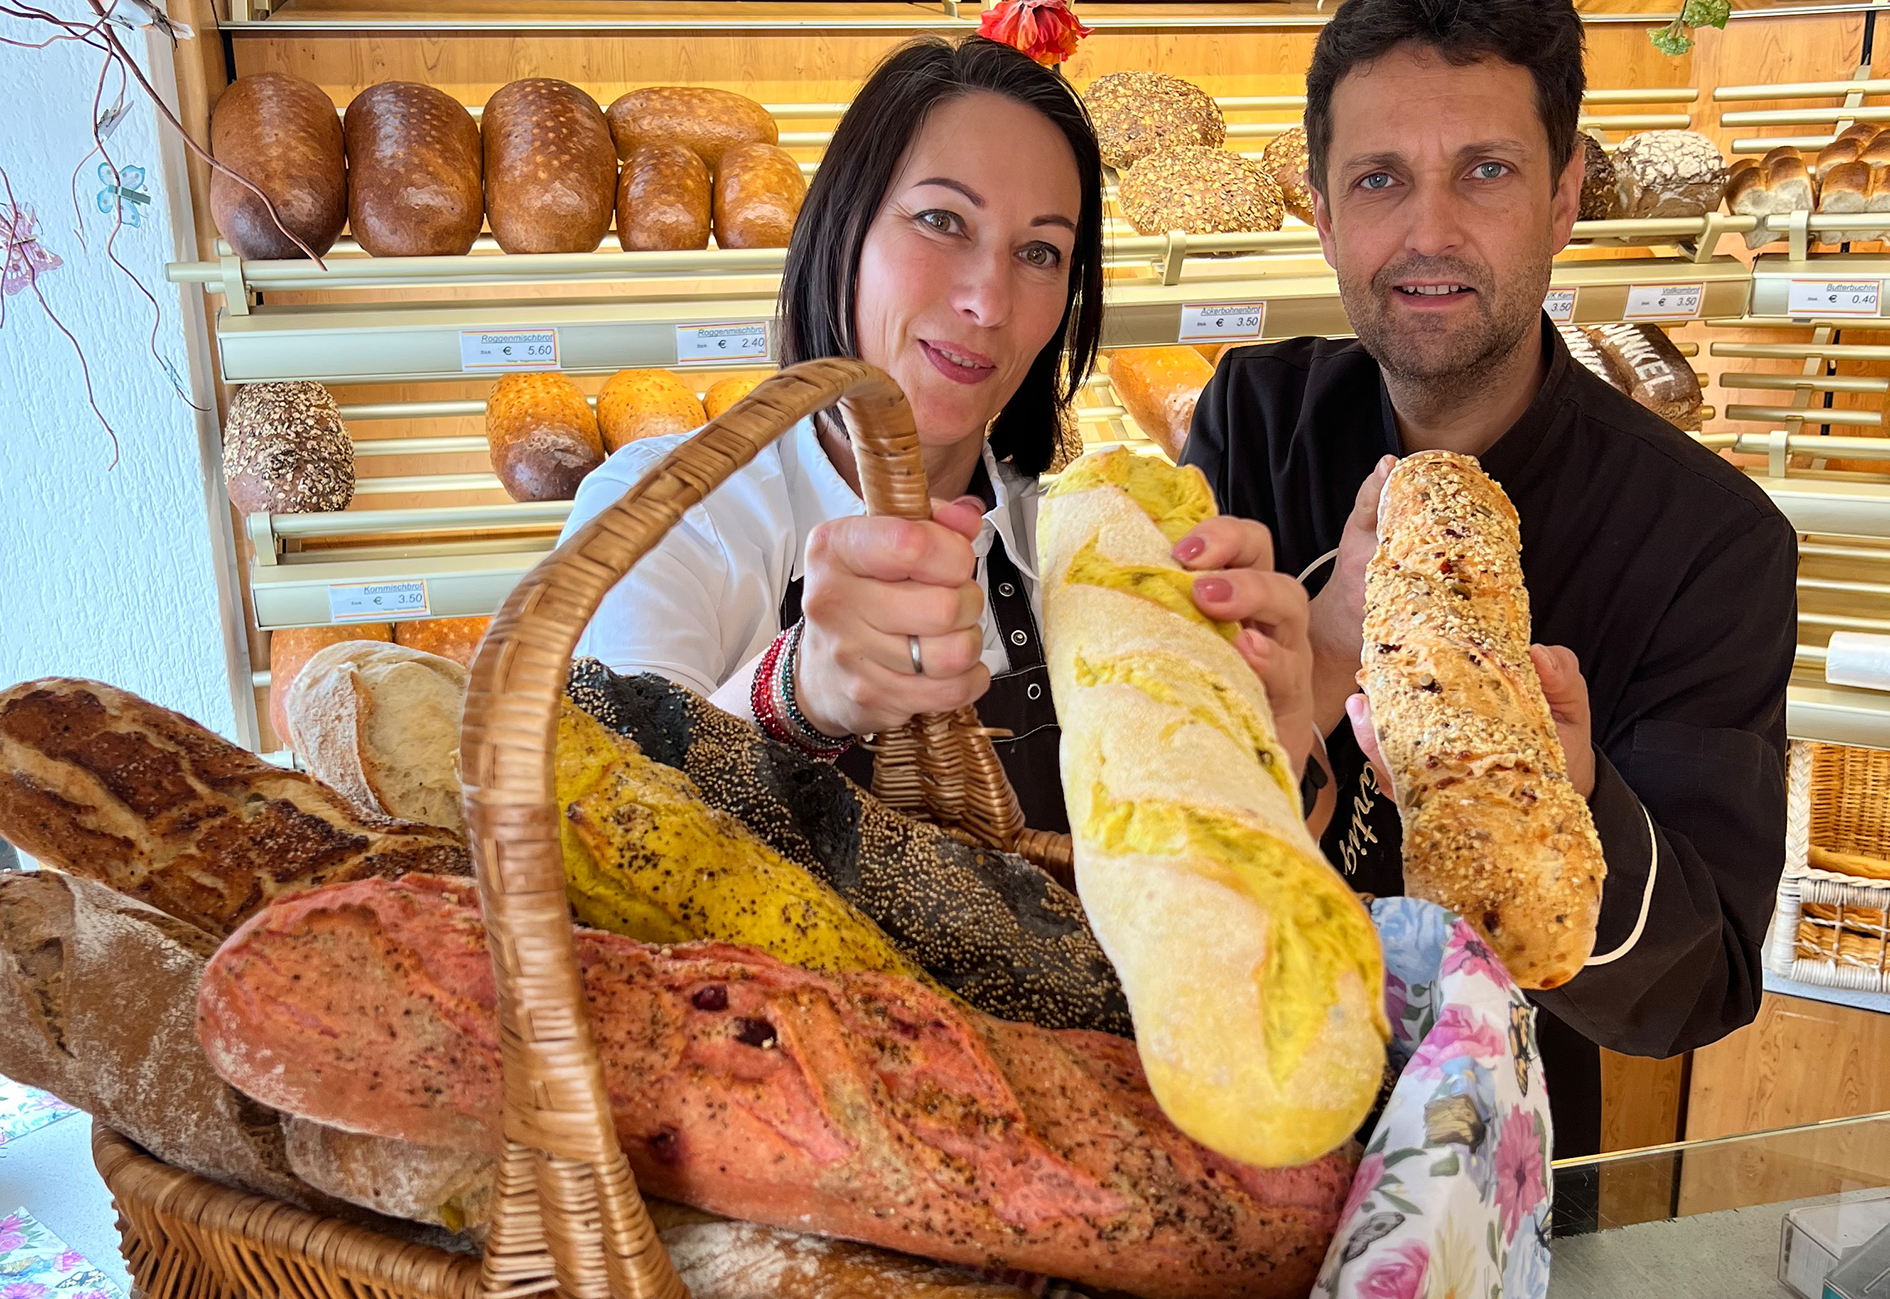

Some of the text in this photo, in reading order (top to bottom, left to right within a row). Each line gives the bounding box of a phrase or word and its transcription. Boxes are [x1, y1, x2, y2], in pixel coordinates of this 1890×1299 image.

[1658, 298, 1666, 307] €
[1677, 297, 1697, 306] 3.50
[1828, 294, 1837, 304] €
[1852, 294, 1876, 304] 0.40
[1201, 306, 1260, 317] Ackerbohnenbrot
[1551, 303, 1571, 312] 3.50
[1216, 318, 1224, 328] €
[1237, 317, 1259, 327] 3.50
[481, 334, 553, 344] Roggenmischbrot
[718, 339, 727, 349] €
[742, 337, 765, 348] 2.40
[502, 346, 512, 356] €
[527, 345, 552, 356] 5.60
[373, 596, 383, 605] €
[398, 593, 423, 604] 3.50
